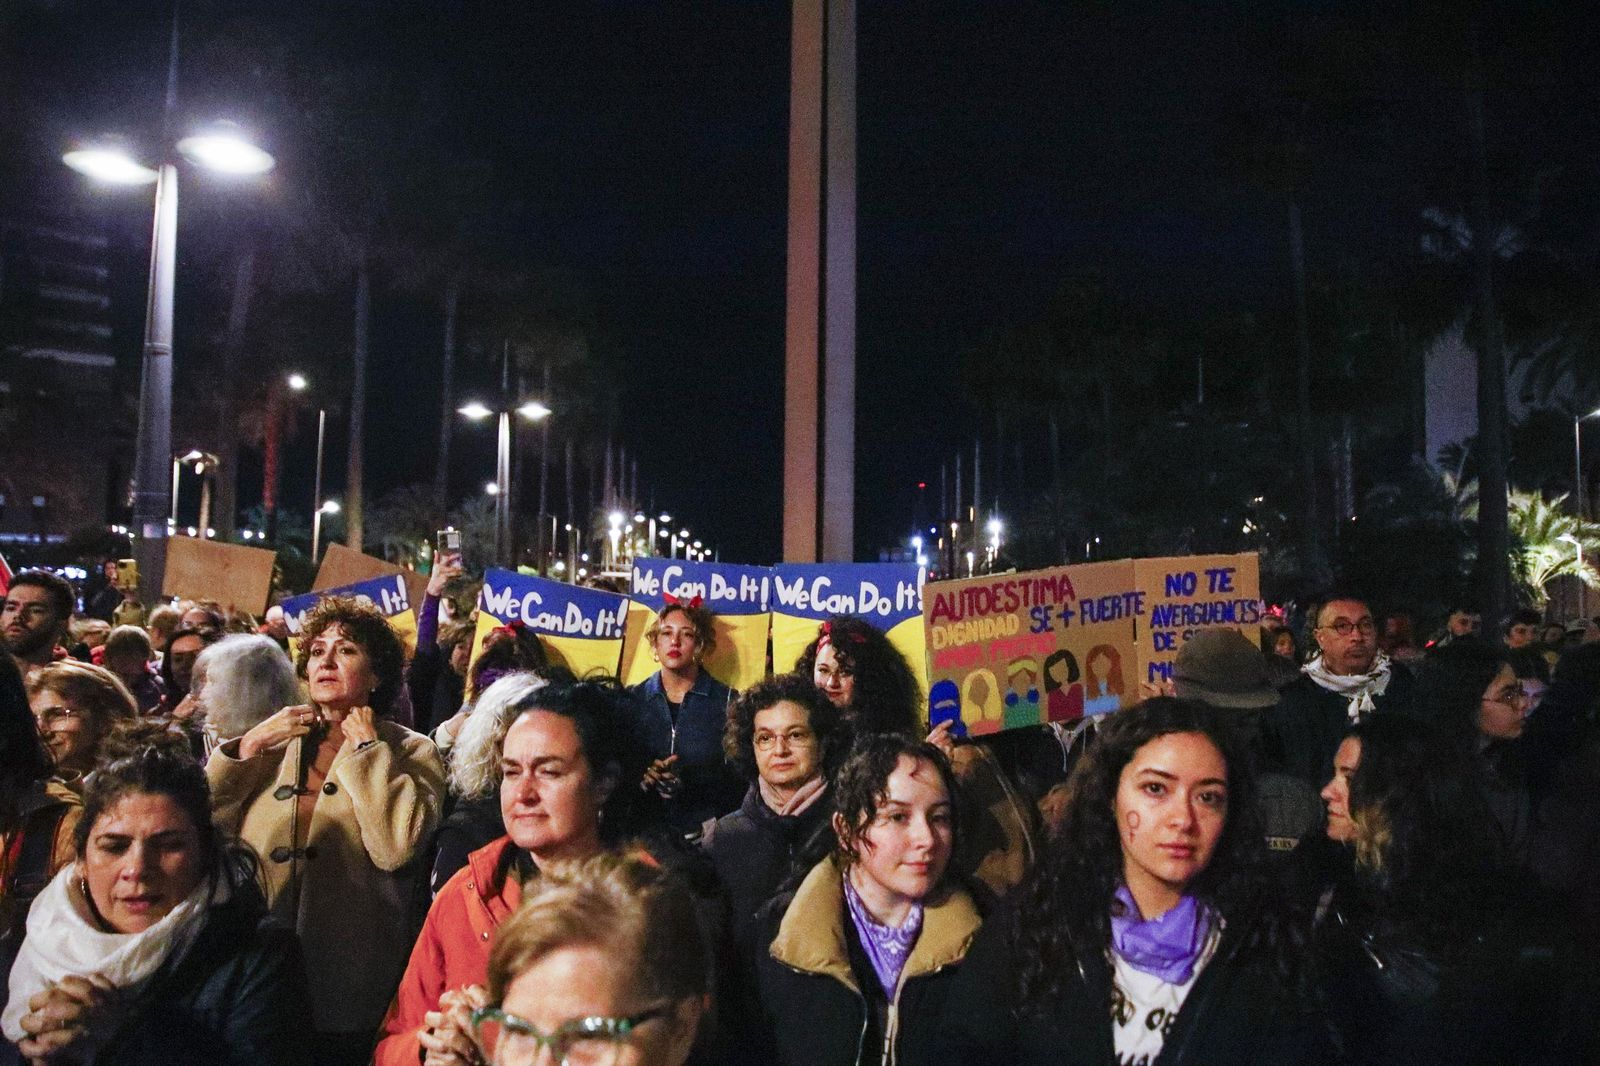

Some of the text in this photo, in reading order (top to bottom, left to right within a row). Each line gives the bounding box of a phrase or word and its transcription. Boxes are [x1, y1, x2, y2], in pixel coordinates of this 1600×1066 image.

[381, 574, 409, 615] It!
[633, 565, 769, 612] We Can Do It!
[774, 566, 926, 616] We Can Do It!
[931, 574, 1076, 623] AUTOESTIMA
[1165, 567, 1236, 598] NO TE
[482, 582, 629, 638] We Can Do It!
[1030, 591, 1147, 634] SE + FUERTE
[1149, 598, 1261, 629] AVERGUENCES
[931, 614, 1020, 650] DIGNIDAD
[1153, 631, 1177, 652] DE
